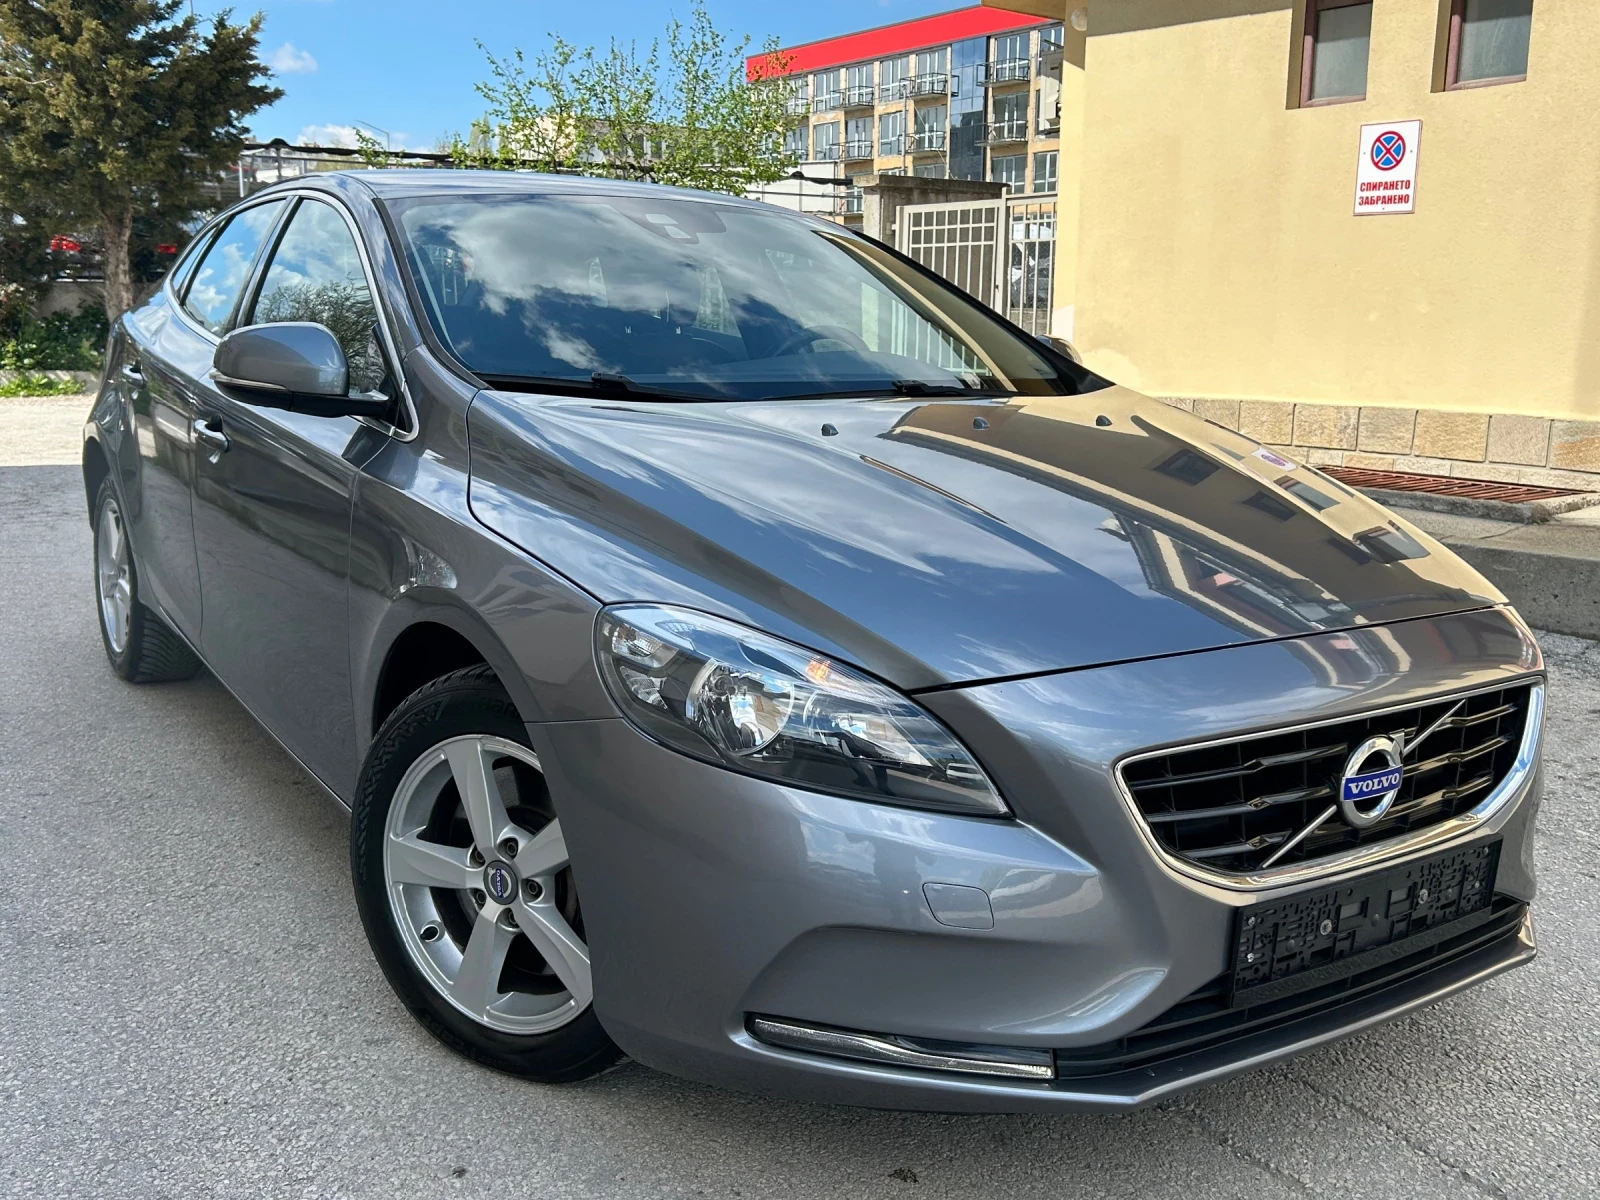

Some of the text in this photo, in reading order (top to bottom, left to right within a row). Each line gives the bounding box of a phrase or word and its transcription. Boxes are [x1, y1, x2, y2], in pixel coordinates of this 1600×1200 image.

[1360, 180, 1411, 192] СПИРАНЕТО
[1358, 194, 1410, 206] ЗАБРАНЕНО
[1348, 772, 1400, 794] VOLVO
